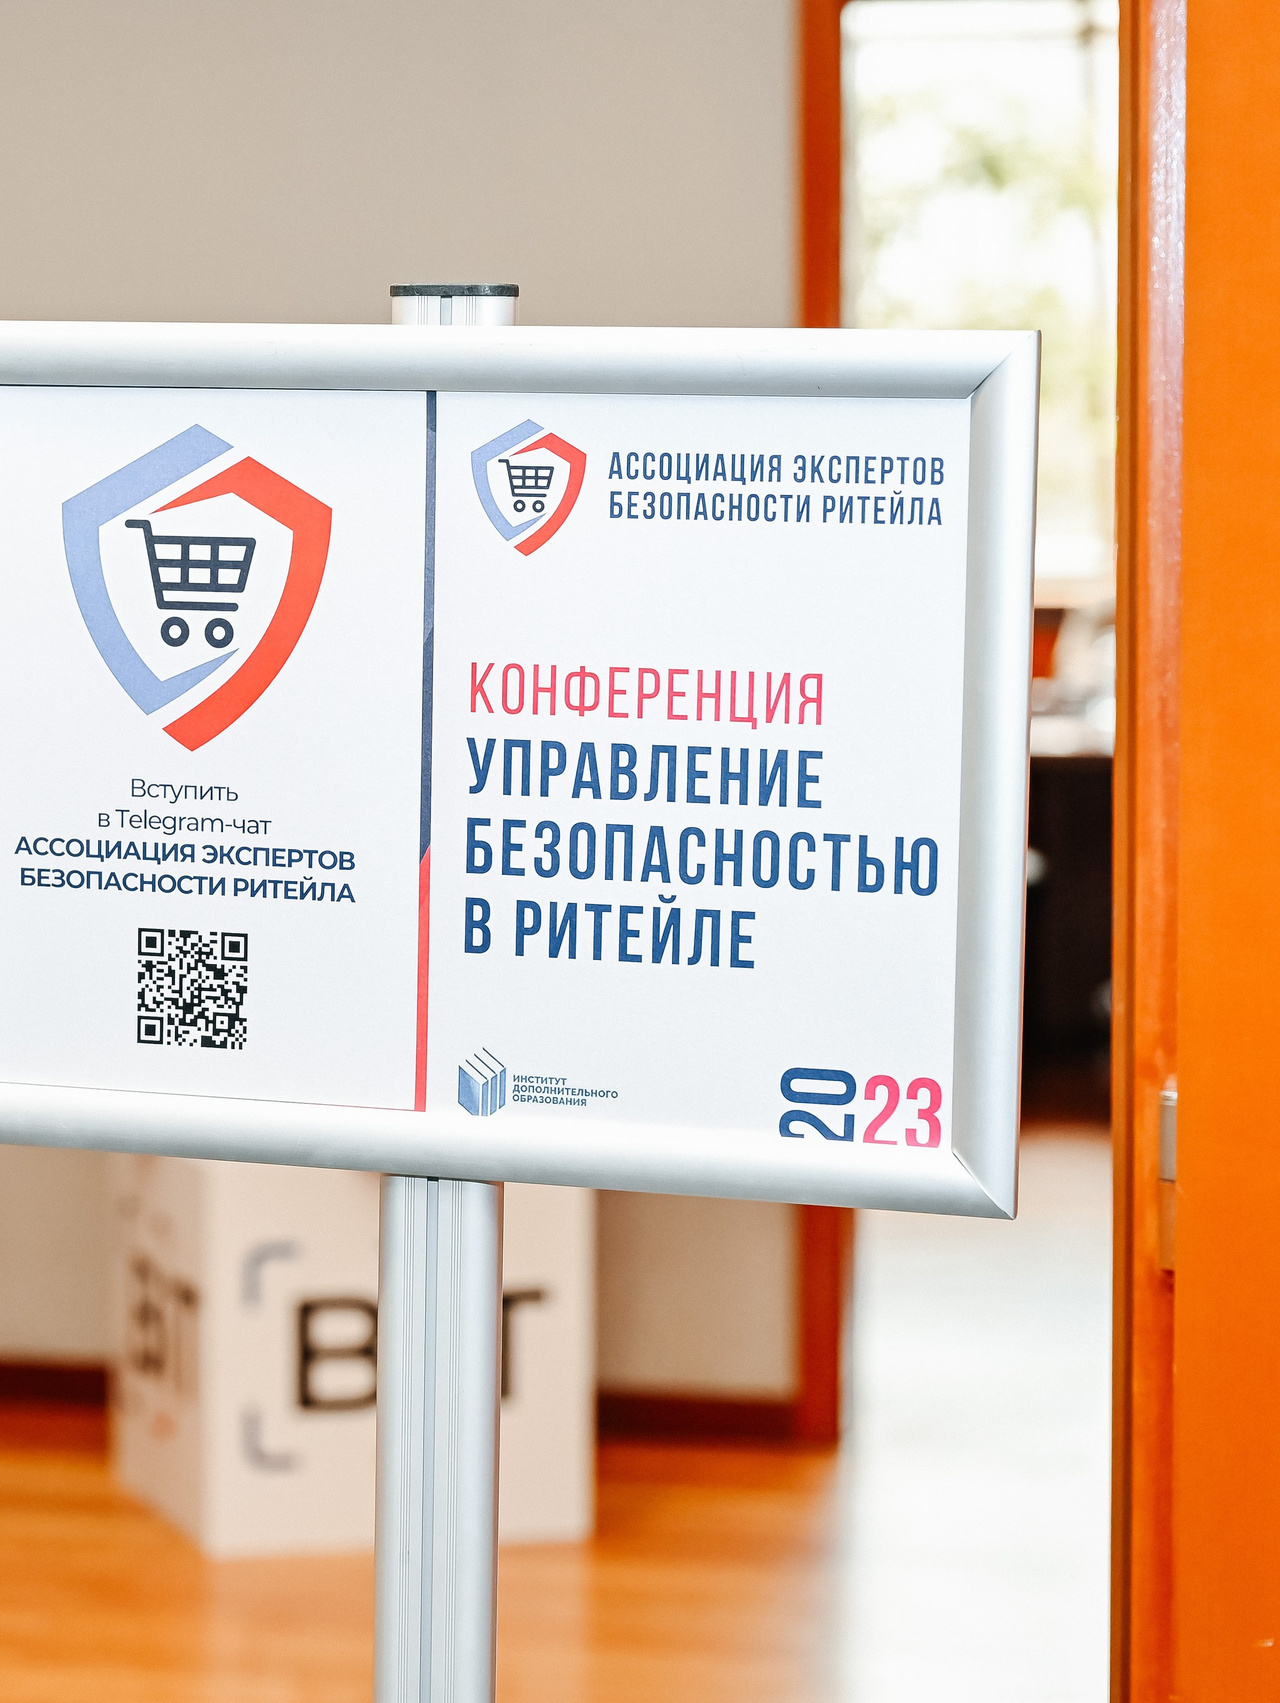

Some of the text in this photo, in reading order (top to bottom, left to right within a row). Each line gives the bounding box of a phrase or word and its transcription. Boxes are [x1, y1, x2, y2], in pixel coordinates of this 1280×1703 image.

[608, 451, 945, 486] АССОЦИАЦИЯ ЭКСПЕРТОВ
[609, 490, 943, 526] БЕЗОПАСНОСТИ РИТЕЙЛА
[470, 661, 824, 730] КОНФЕРЕНЦИЯ
[465, 736, 824, 809] УПРАВЛЕНИЕ
[130, 778, 239, 804] Вступить
[97, 808, 272, 836] в Telegram-чат
[14, 835, 356, 871] АССОЦИАЦИЯ ЭКСПЕРТОВ
[465, 816, 939, 897] БЕЗОПАСНОСТЬЮ
[20, 867, 356, 903] БЕЗОПАСНОСТИ РИТЕЙЛА
[464, 893, 756, 970] В РИТЕЙЛЕ
[512, 1074, 568, 1086] ИНСТИТУТ
[512, 1084, 619, 1099] ДОПОЛНИТЕЛЬНОГО
[512, 1093, 588, 1107] ОБРАЗОВАНИЯ
